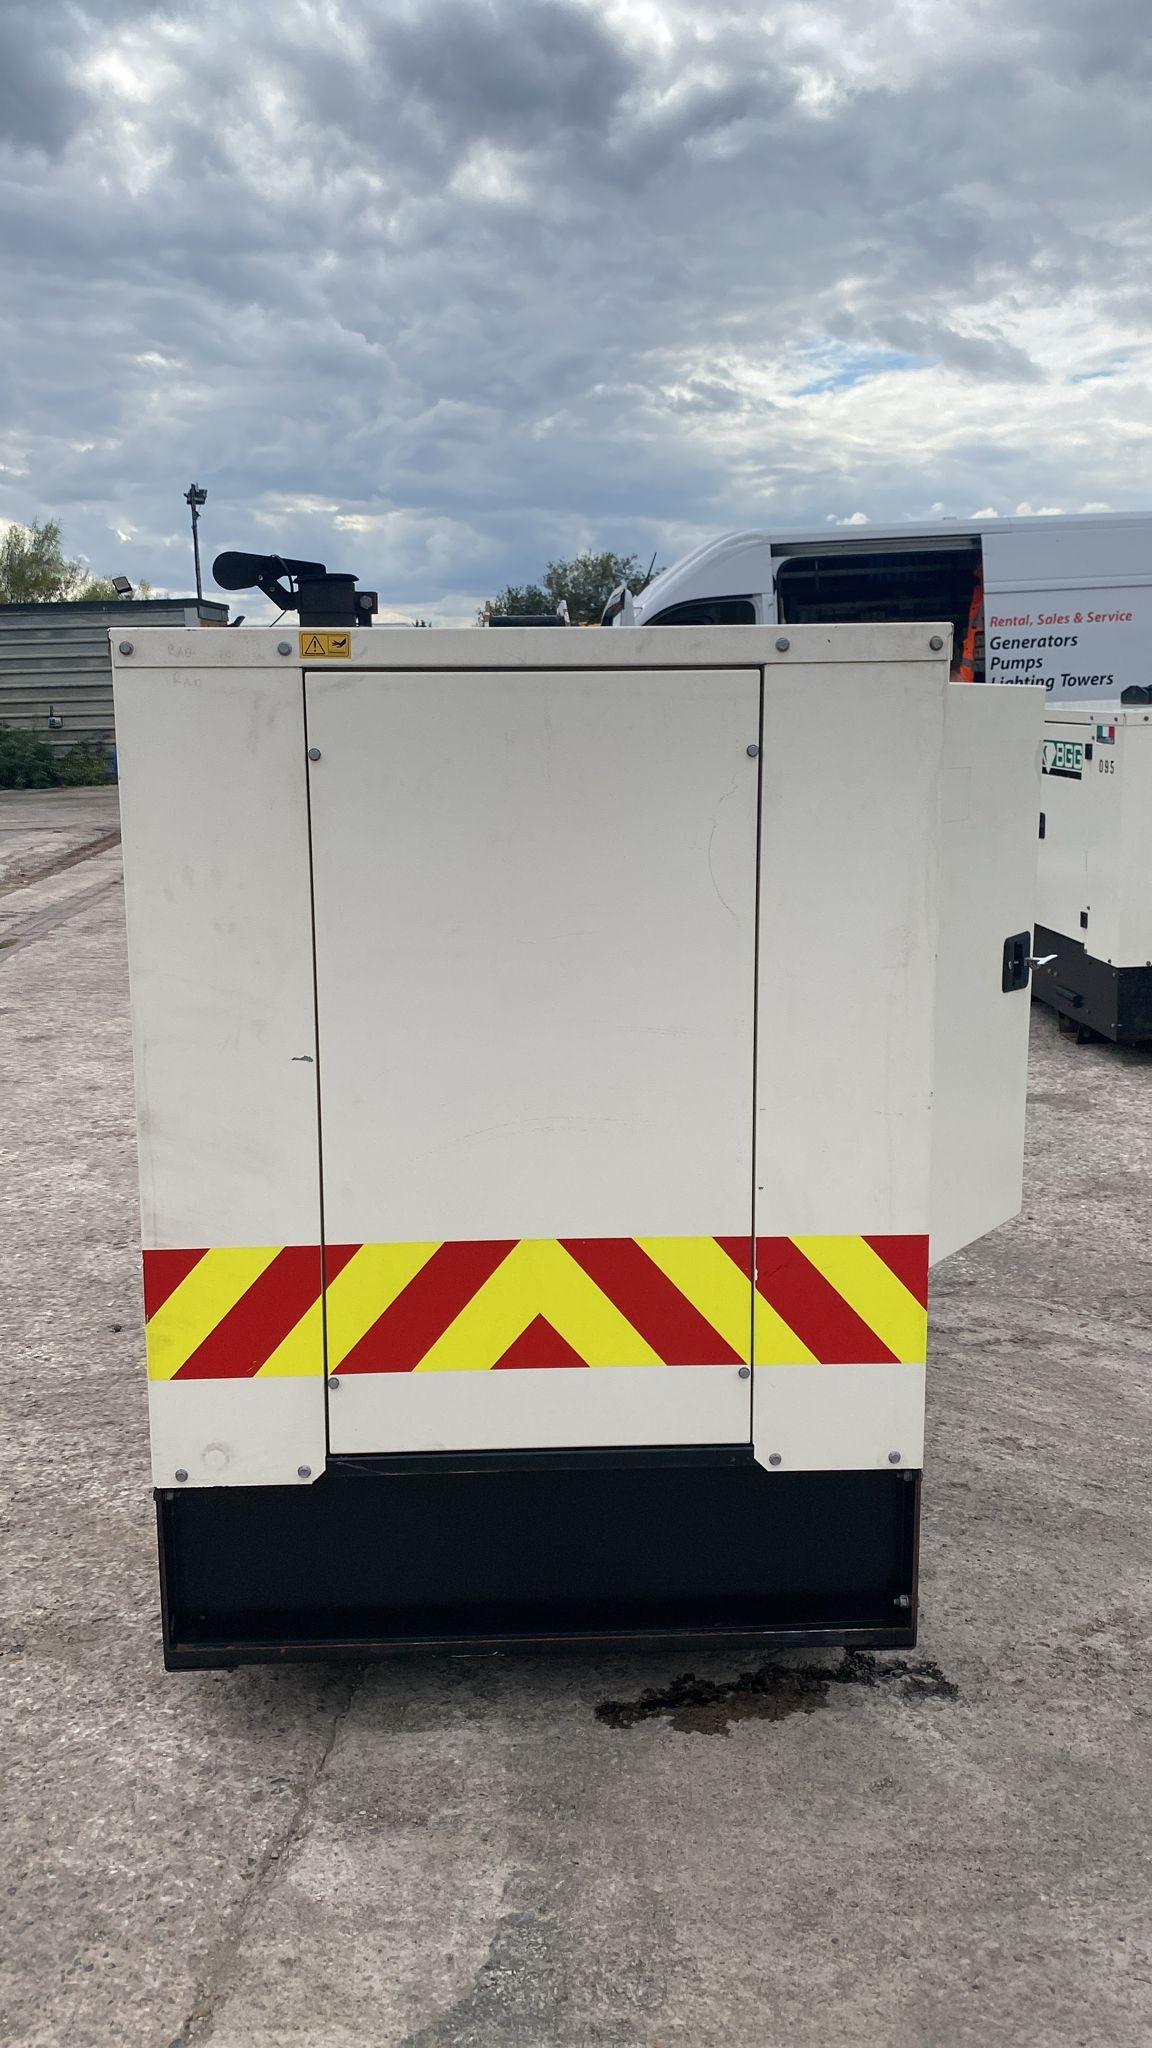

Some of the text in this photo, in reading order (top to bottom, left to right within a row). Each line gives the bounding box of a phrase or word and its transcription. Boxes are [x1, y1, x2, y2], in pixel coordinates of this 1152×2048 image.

[989, 610, 1133, 628] Rental, Sales & Service
[990, 635, 1078, 650] Generators
[990, 656, 1043, 673] Pumps
[1060, 672, 1114, 687] Towers
[1099, 759, 1115, 774] 095
